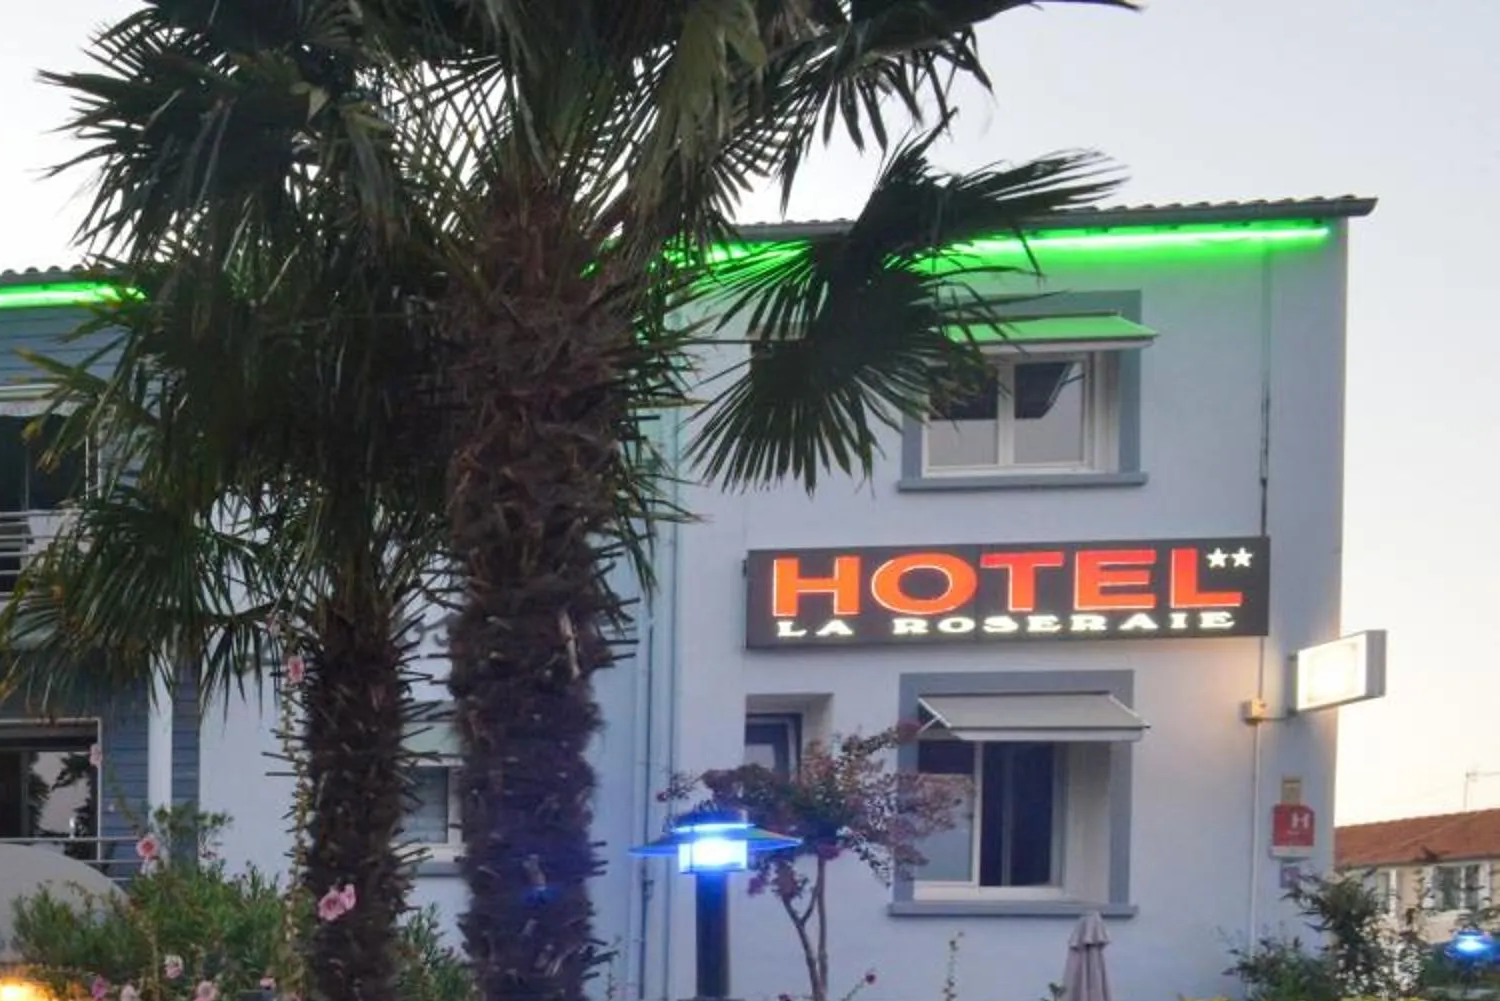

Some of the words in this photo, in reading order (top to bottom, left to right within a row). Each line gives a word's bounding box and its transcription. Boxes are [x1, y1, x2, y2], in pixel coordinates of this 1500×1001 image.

[772, 548, 1243, 616] HOTEL
[776, 619, 854, 637] LA
[892, 611, 1236, 635] ROSERAIE
